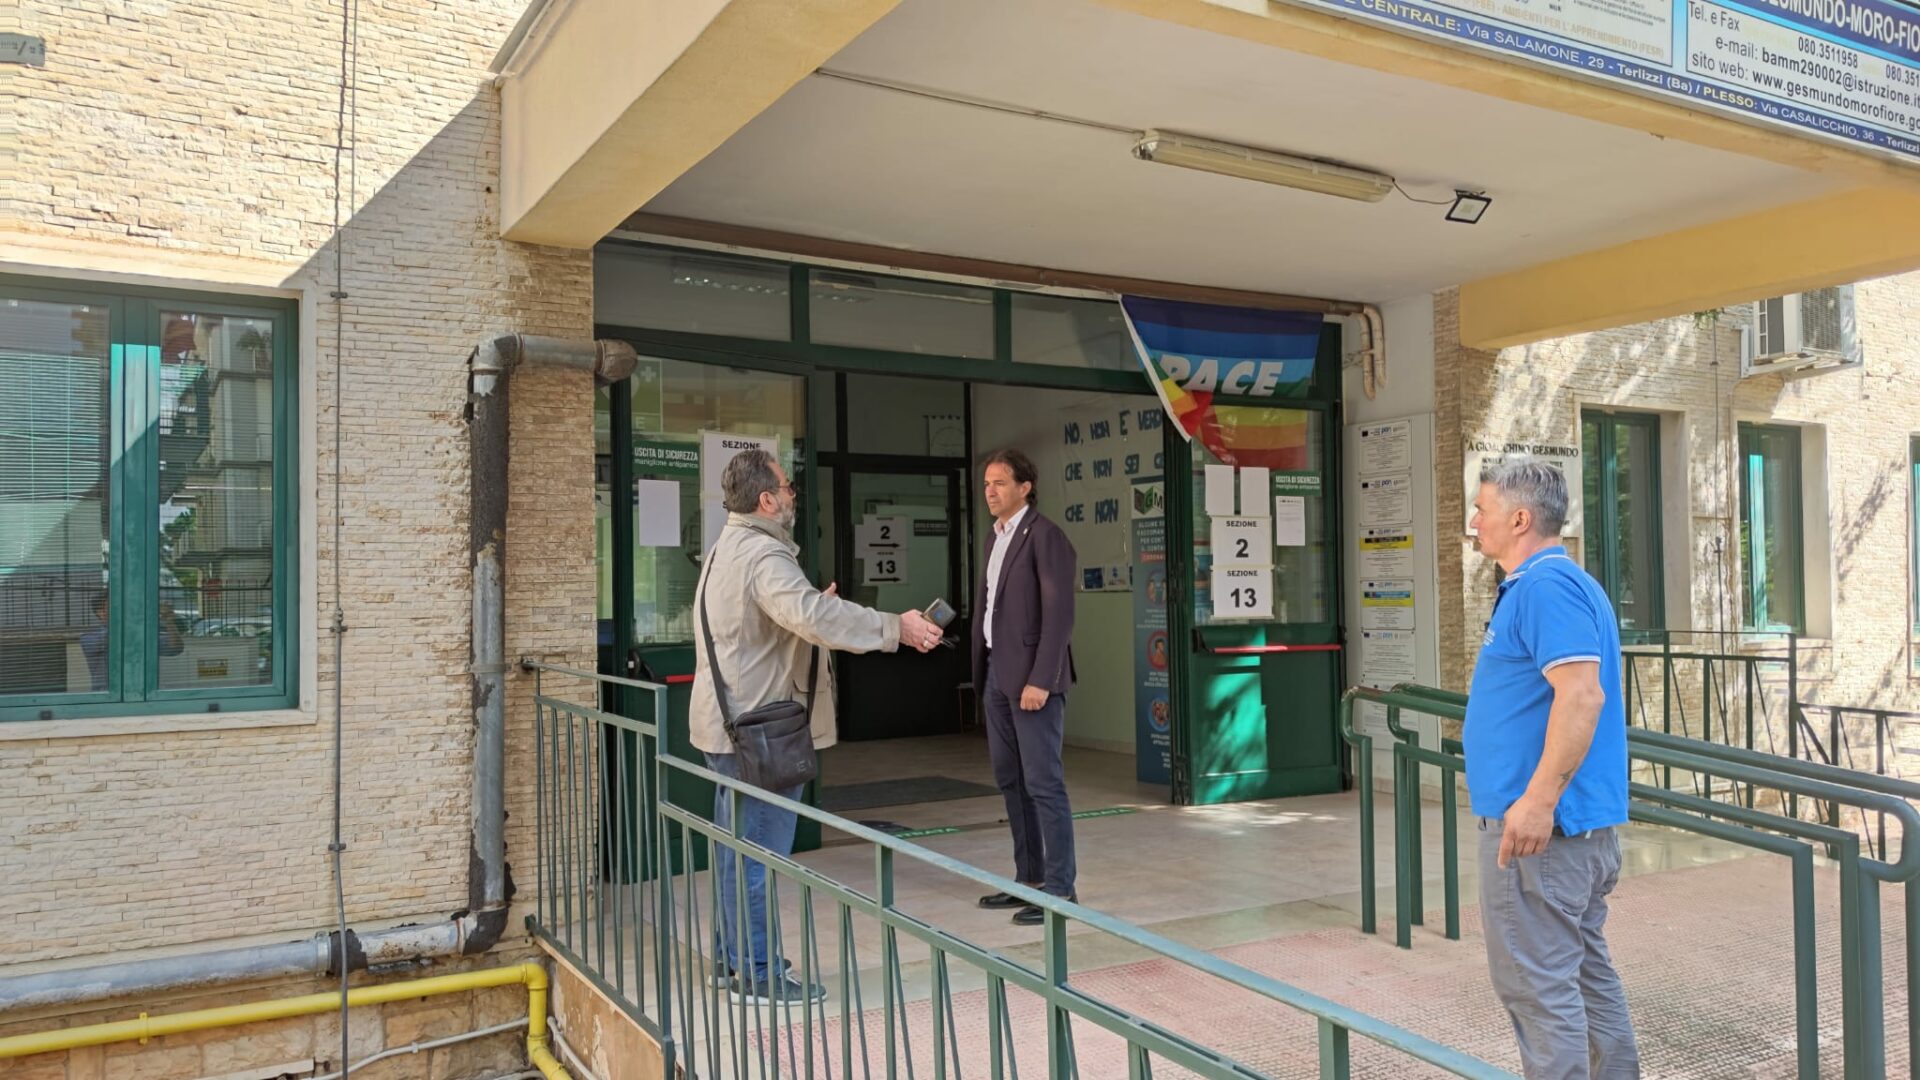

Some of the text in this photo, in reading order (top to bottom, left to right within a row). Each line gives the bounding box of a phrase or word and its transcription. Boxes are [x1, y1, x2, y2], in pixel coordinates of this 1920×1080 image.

[1688, 1, 1707, 22] Tel.
[1711, 12, 1717, 24] e
[1721, 11, 1740, 31] Fax
[1798, 37, 1858, 69] 080.3511958
[1716, 37, 1758, 60] e-mail:
[1692, 51, 1715, 70] sito
[1719, 61, 1748, 80] web:
[1359, 0, 1461, 32] CENTRALE:
[1467, 24, 1489, 39] Via
[1494, 31, 1583, 65] SALAMONE,
[1588, 56, 1604, 69] 29
[1617, 63, 1663, 84] Terlizzi
[1667, 77, 1692, 94] (Ba)
[1703, 86, 1758, 109] PLESSO:
[1761, 102, 1778, 115] Via
[1781, 108, 1860, 137] CASALICCHIO,
[1863, 130, 1874, 141] 36
[1887, 136, 1919, 153] Terlizzi
[1160, 354, 1283, 396] PACE
[634, 446, 698, 461] USCITA DI SICUREZZA
[722, 440, 760, 450] SEZIONE
[1468, 442, 1579, 457] A GIOCHINO GESMUNDO
[880, 526, 891, 539] 2
[1226, 520, 1257, 528] SEZIONE
[1236, 538, 1249, 558] 2
[877, 560, 896, 574] 13
[1230, 588, 1257, 608] 13
